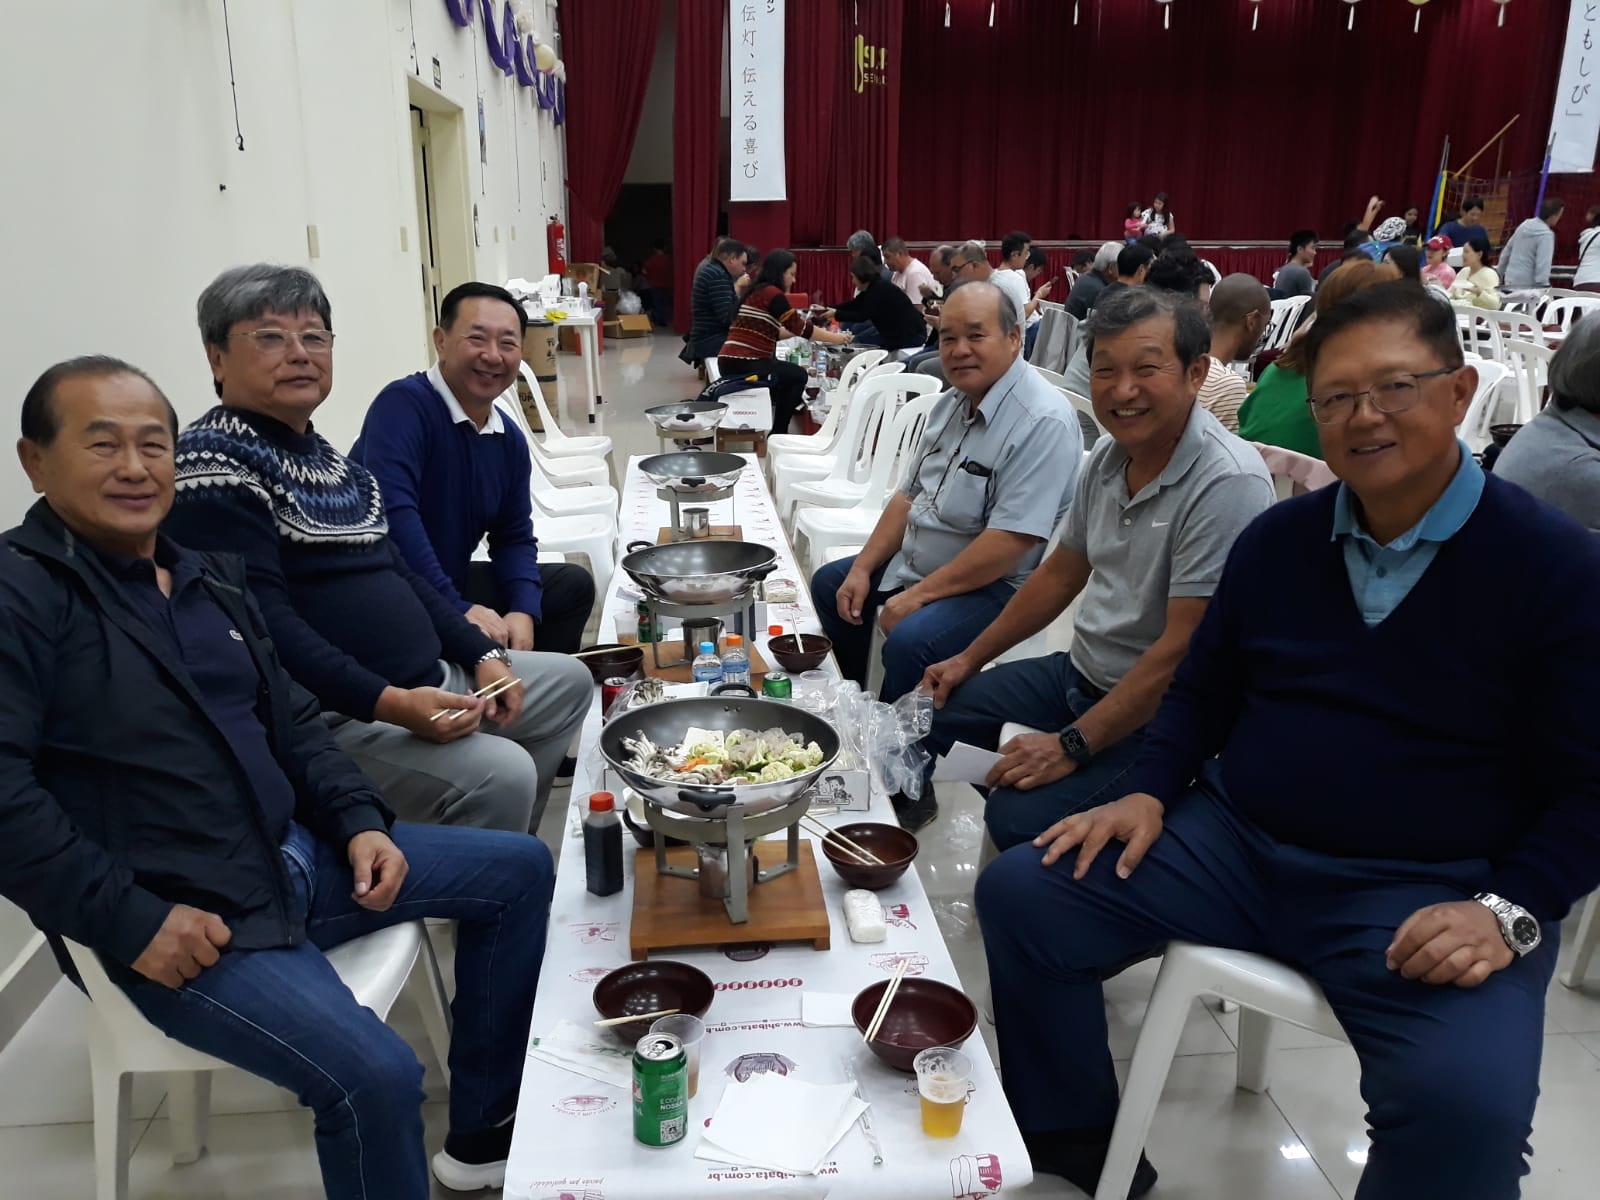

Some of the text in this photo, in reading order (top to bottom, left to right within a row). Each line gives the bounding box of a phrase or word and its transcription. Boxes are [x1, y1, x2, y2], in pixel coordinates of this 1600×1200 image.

[741, 4, 759, 179] 伝灯、伝える喜び
[706, 1021, 802, 1034] ww.shibata.com.b
